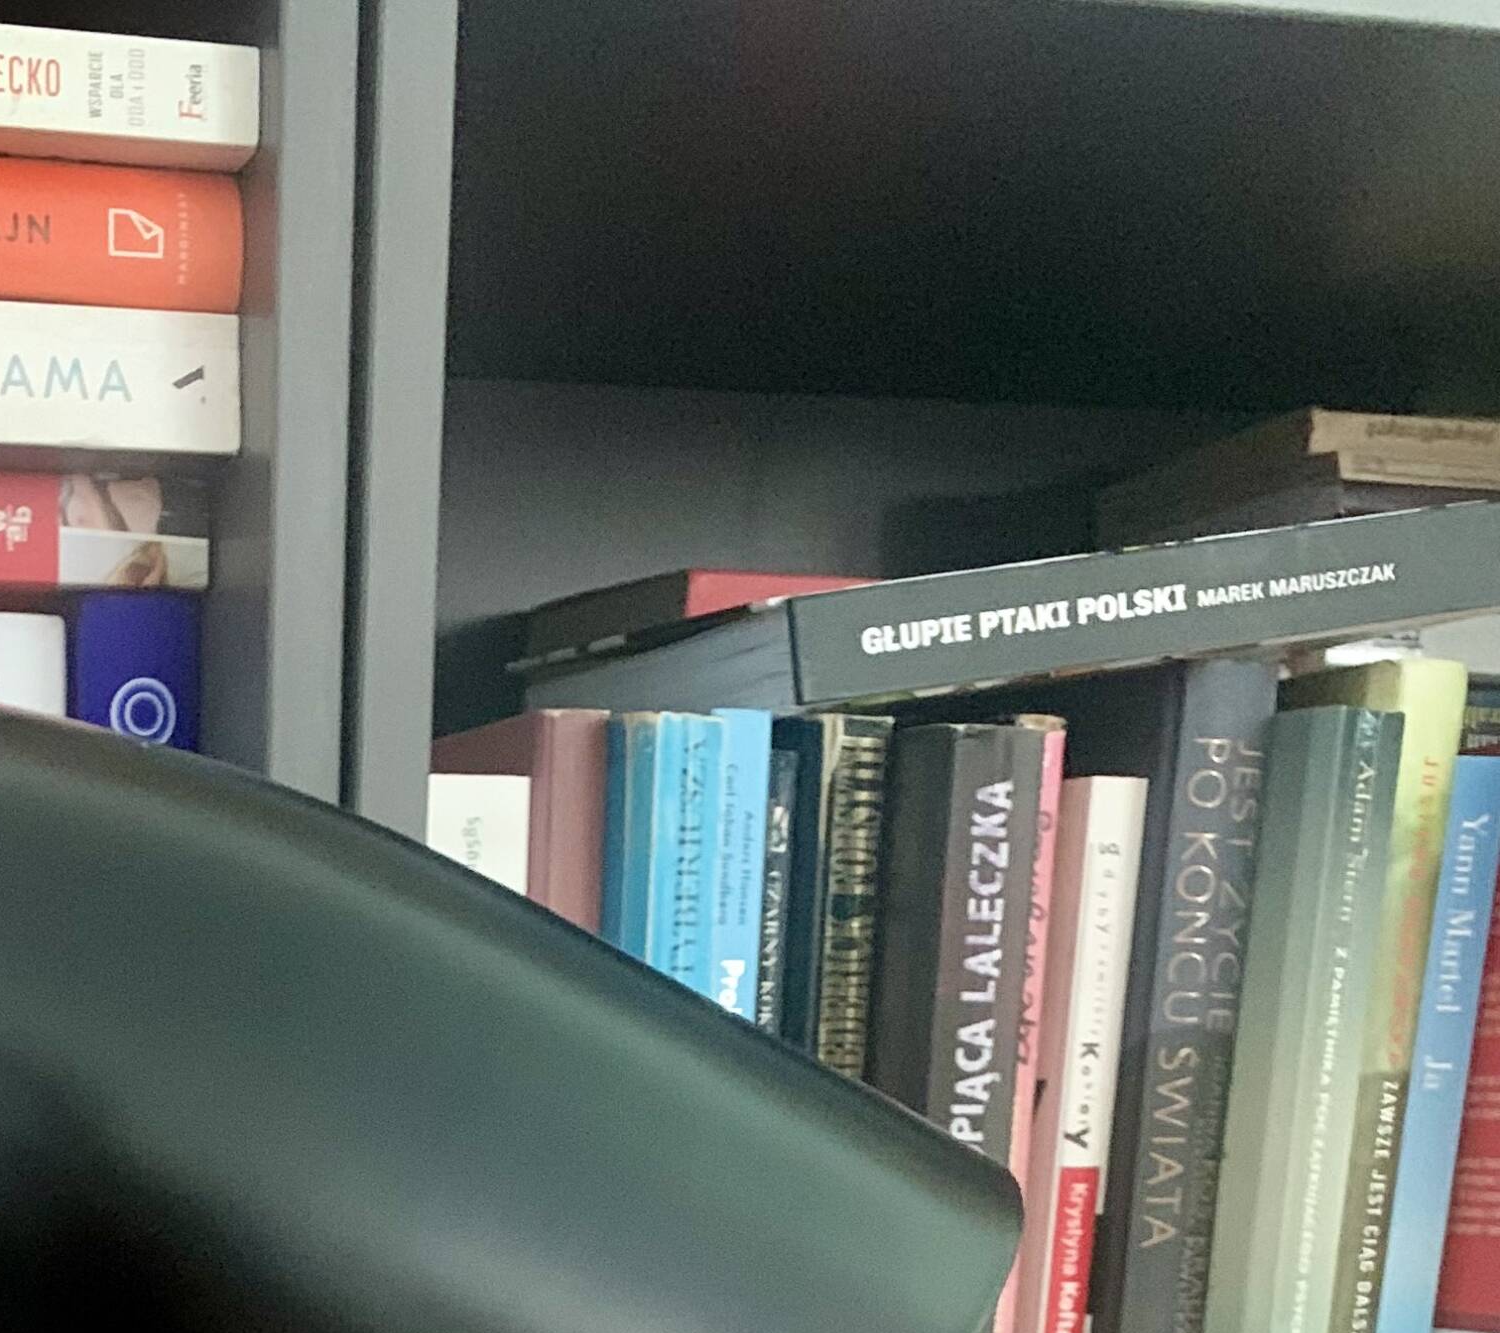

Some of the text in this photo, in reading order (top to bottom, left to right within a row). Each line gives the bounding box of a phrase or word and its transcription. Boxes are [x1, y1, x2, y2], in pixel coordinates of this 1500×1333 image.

[178, 63, 202, 121] Feeria
[860, 563, 1397, 655] GŁUPIE PTAKI POLSKI MAREK MARUSZCZAK
[1187, 737, 1233, 809] PO
[1348, 759, 1377, 843] Adam
[960, 779, 1015, 1002] LALECZKA
[1435, 813, 1491, 1014] Yann Martel
[1373, 1079, 1399, 1160] ZAWSZE
[1365, 1168, 1389, 1217] JEST
